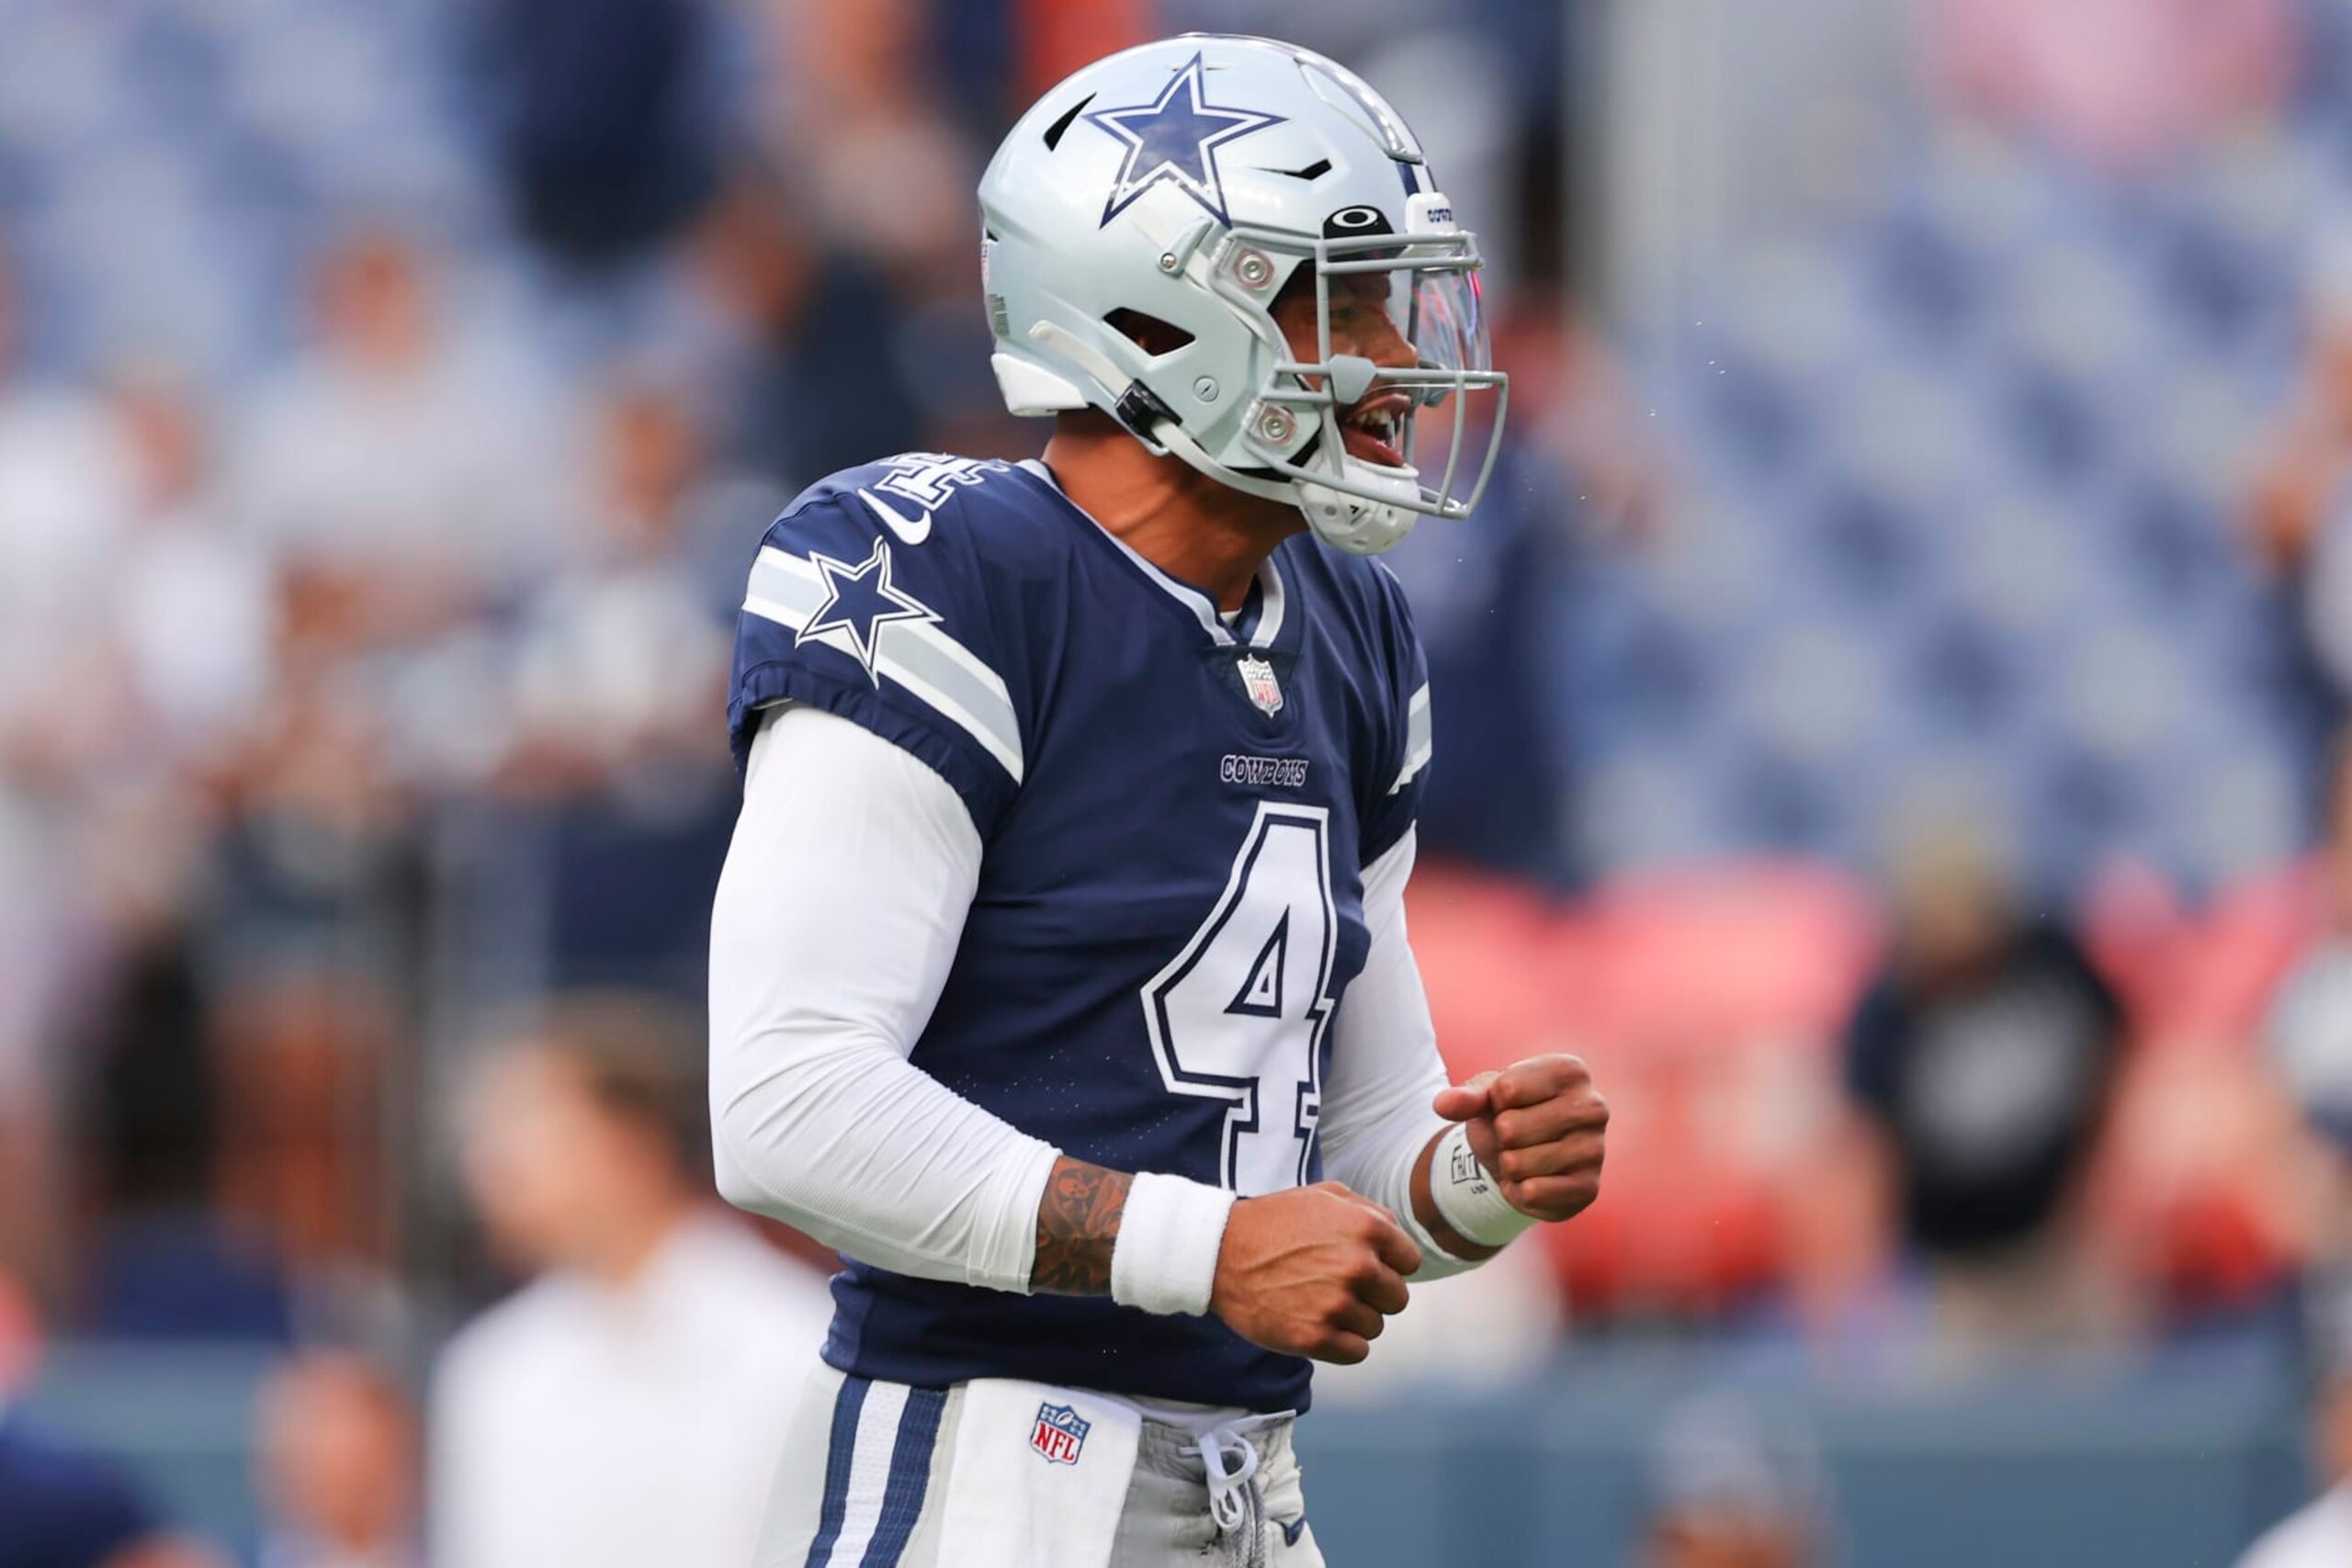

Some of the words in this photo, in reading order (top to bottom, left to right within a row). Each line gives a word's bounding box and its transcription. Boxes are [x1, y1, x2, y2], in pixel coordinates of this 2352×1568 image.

[1220, 754, 1309, 787] COWBOYS
[1139, 800, 1338, 1195] 4
[1034, 1422, 1076, 1461] NFL
